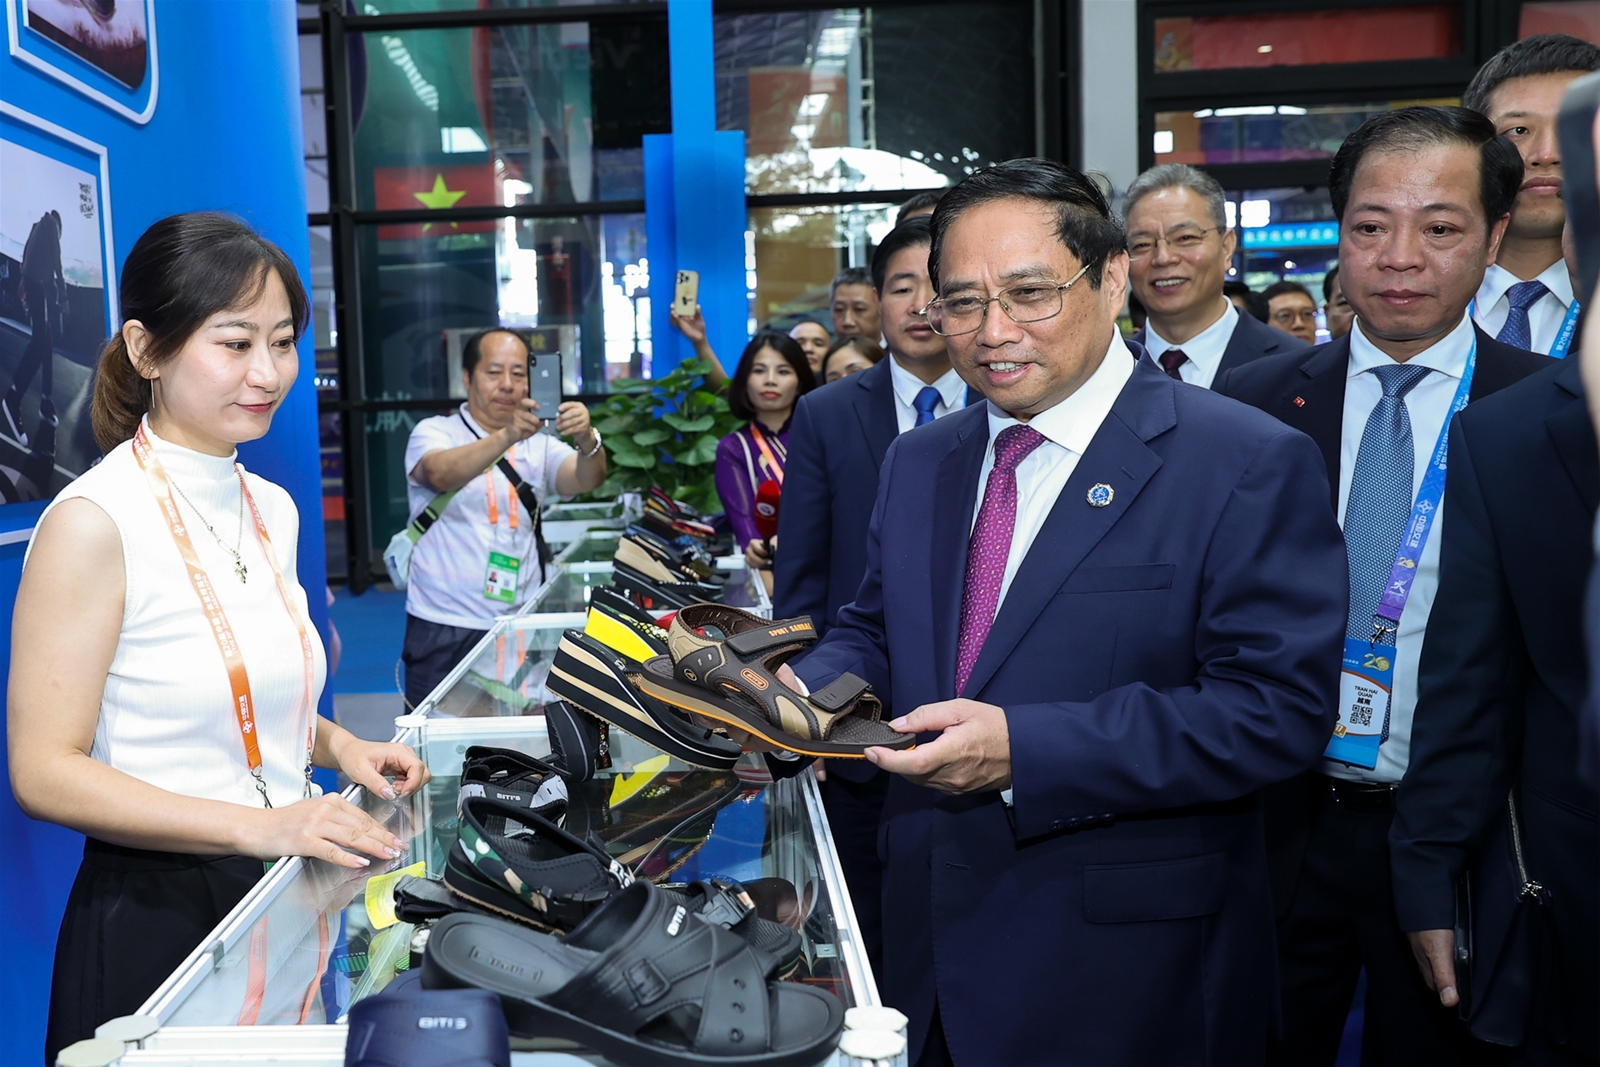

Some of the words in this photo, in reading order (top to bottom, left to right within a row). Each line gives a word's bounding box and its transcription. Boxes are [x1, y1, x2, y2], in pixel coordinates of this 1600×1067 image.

[1410, 515, 1427, 548] 中国交建
[768, 627, 789, 637] SPORT
[789, 622, 812, 632] SANDAL
[1357, 697, 1371, 705] 越南
[496, 792, 521, 801] BITI'S
